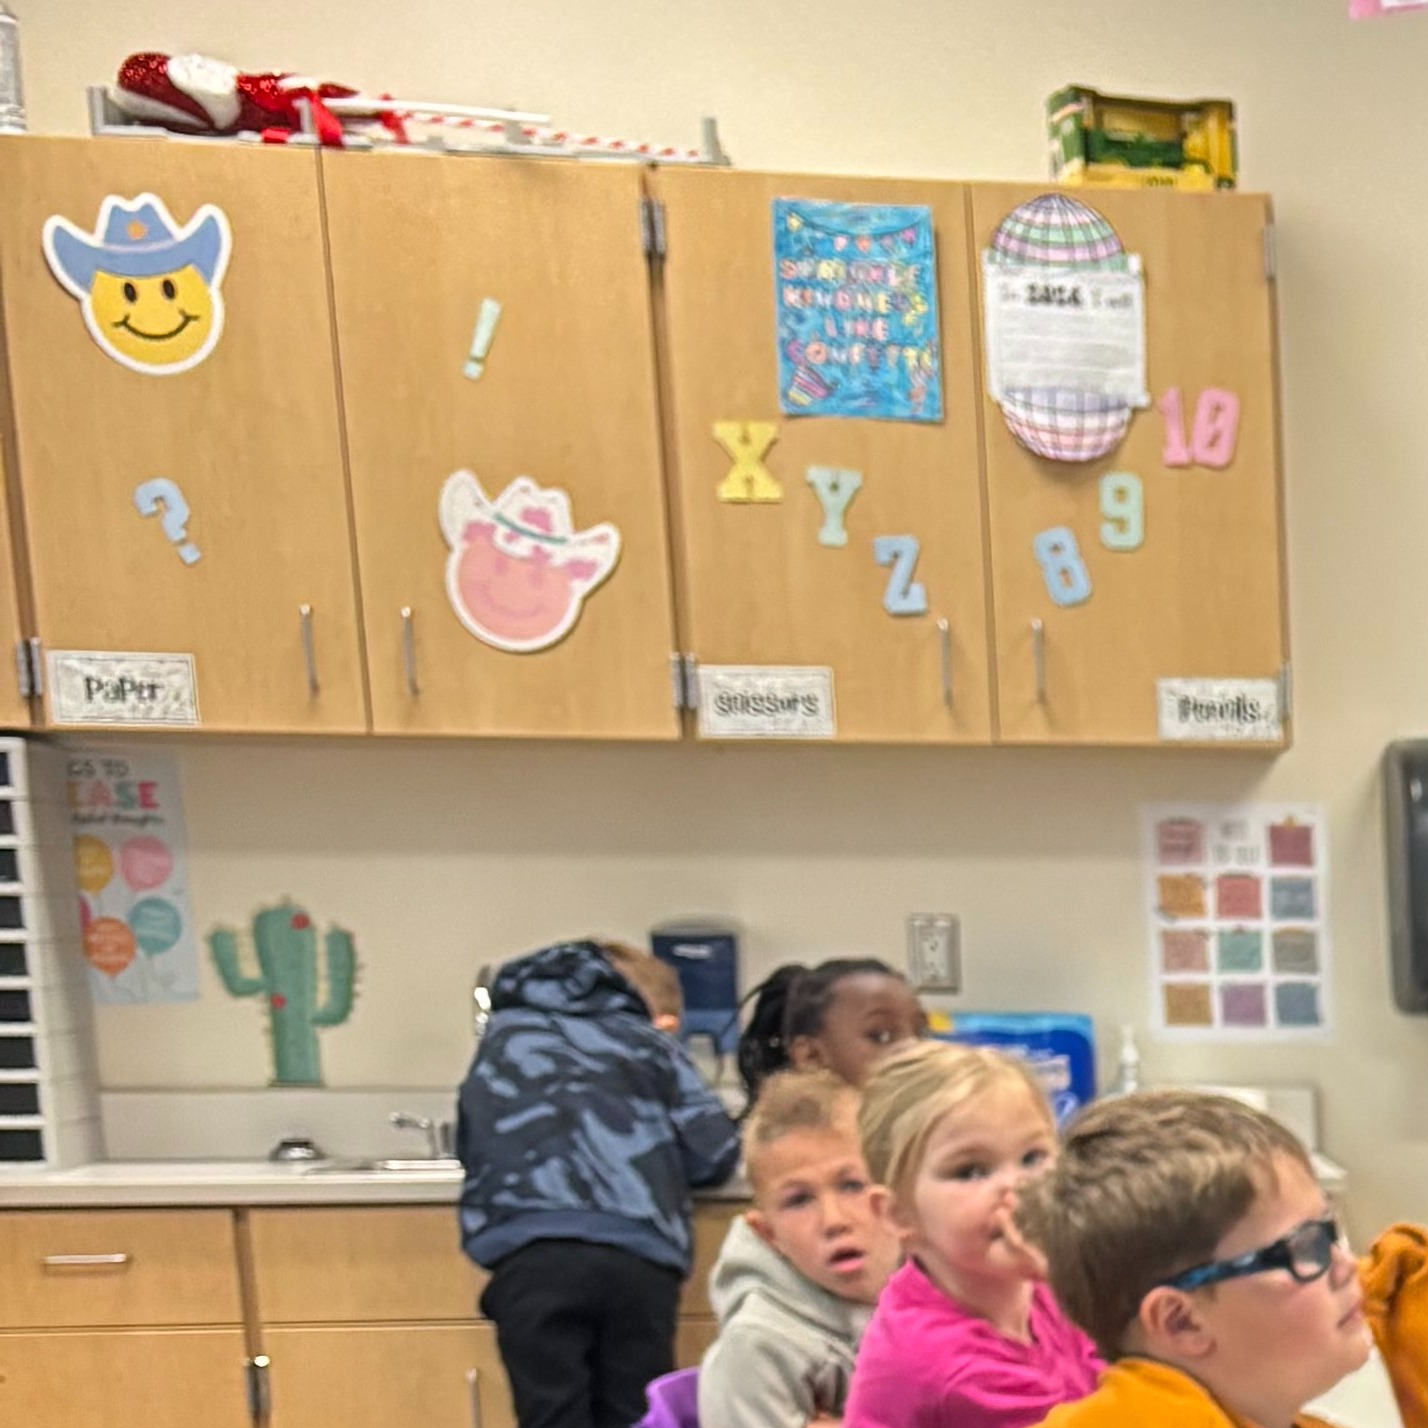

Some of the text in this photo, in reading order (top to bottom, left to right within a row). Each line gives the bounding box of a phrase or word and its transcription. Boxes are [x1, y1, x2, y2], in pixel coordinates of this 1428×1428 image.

[712, 421, 928, 616] X Y Z
[1033, 387, 1241, 607] 8 9 10
